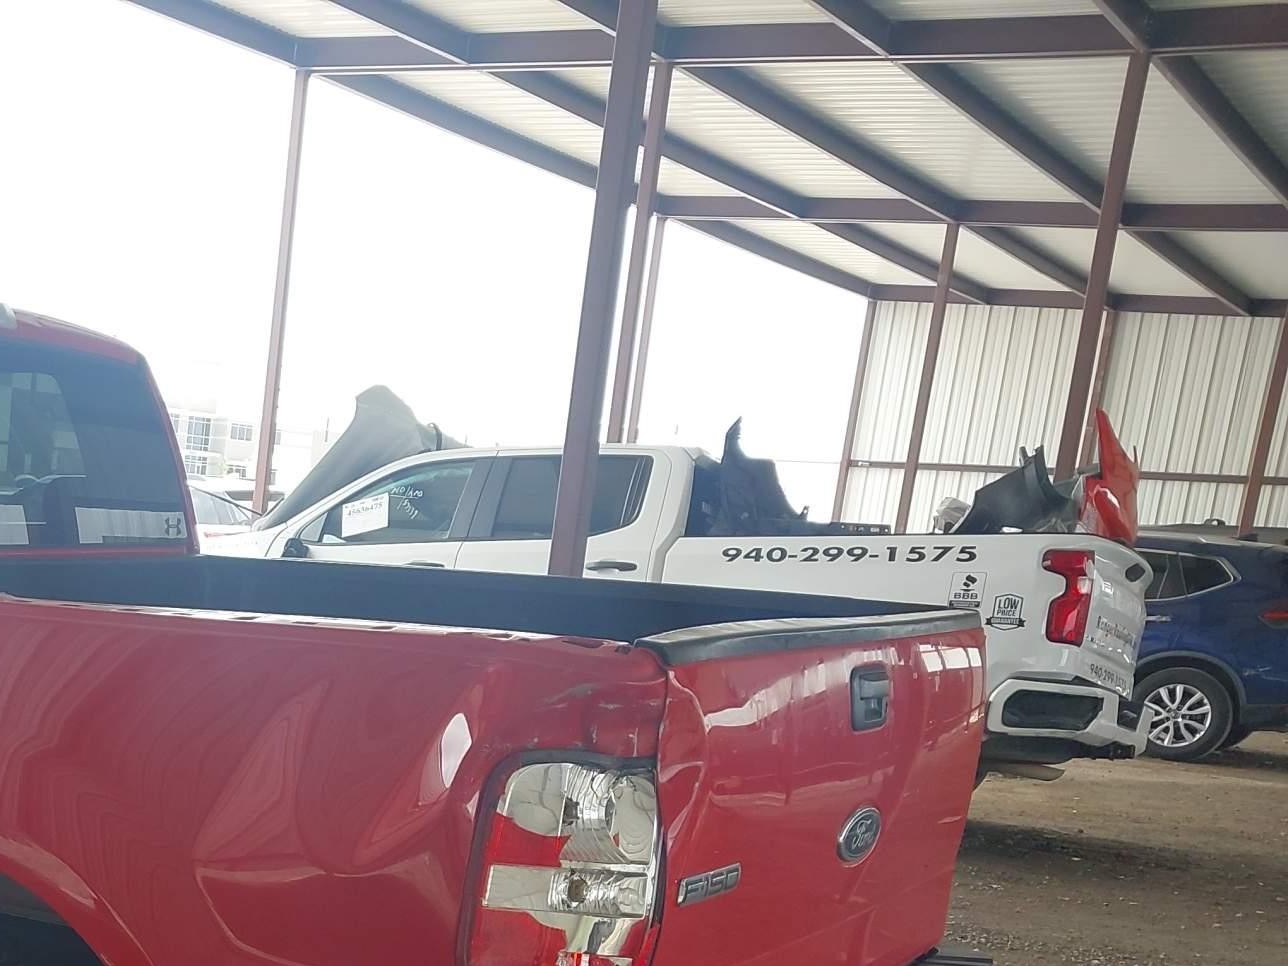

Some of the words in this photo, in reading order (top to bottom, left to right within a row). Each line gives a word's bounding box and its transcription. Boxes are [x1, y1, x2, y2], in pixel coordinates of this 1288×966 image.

[722, 545, 978, 563] 940-299-1575
[953, 592, 978, 600] BBB
[997, 597, 1020, 609] LOW
[997, 609, 1017, 617] PRICE
